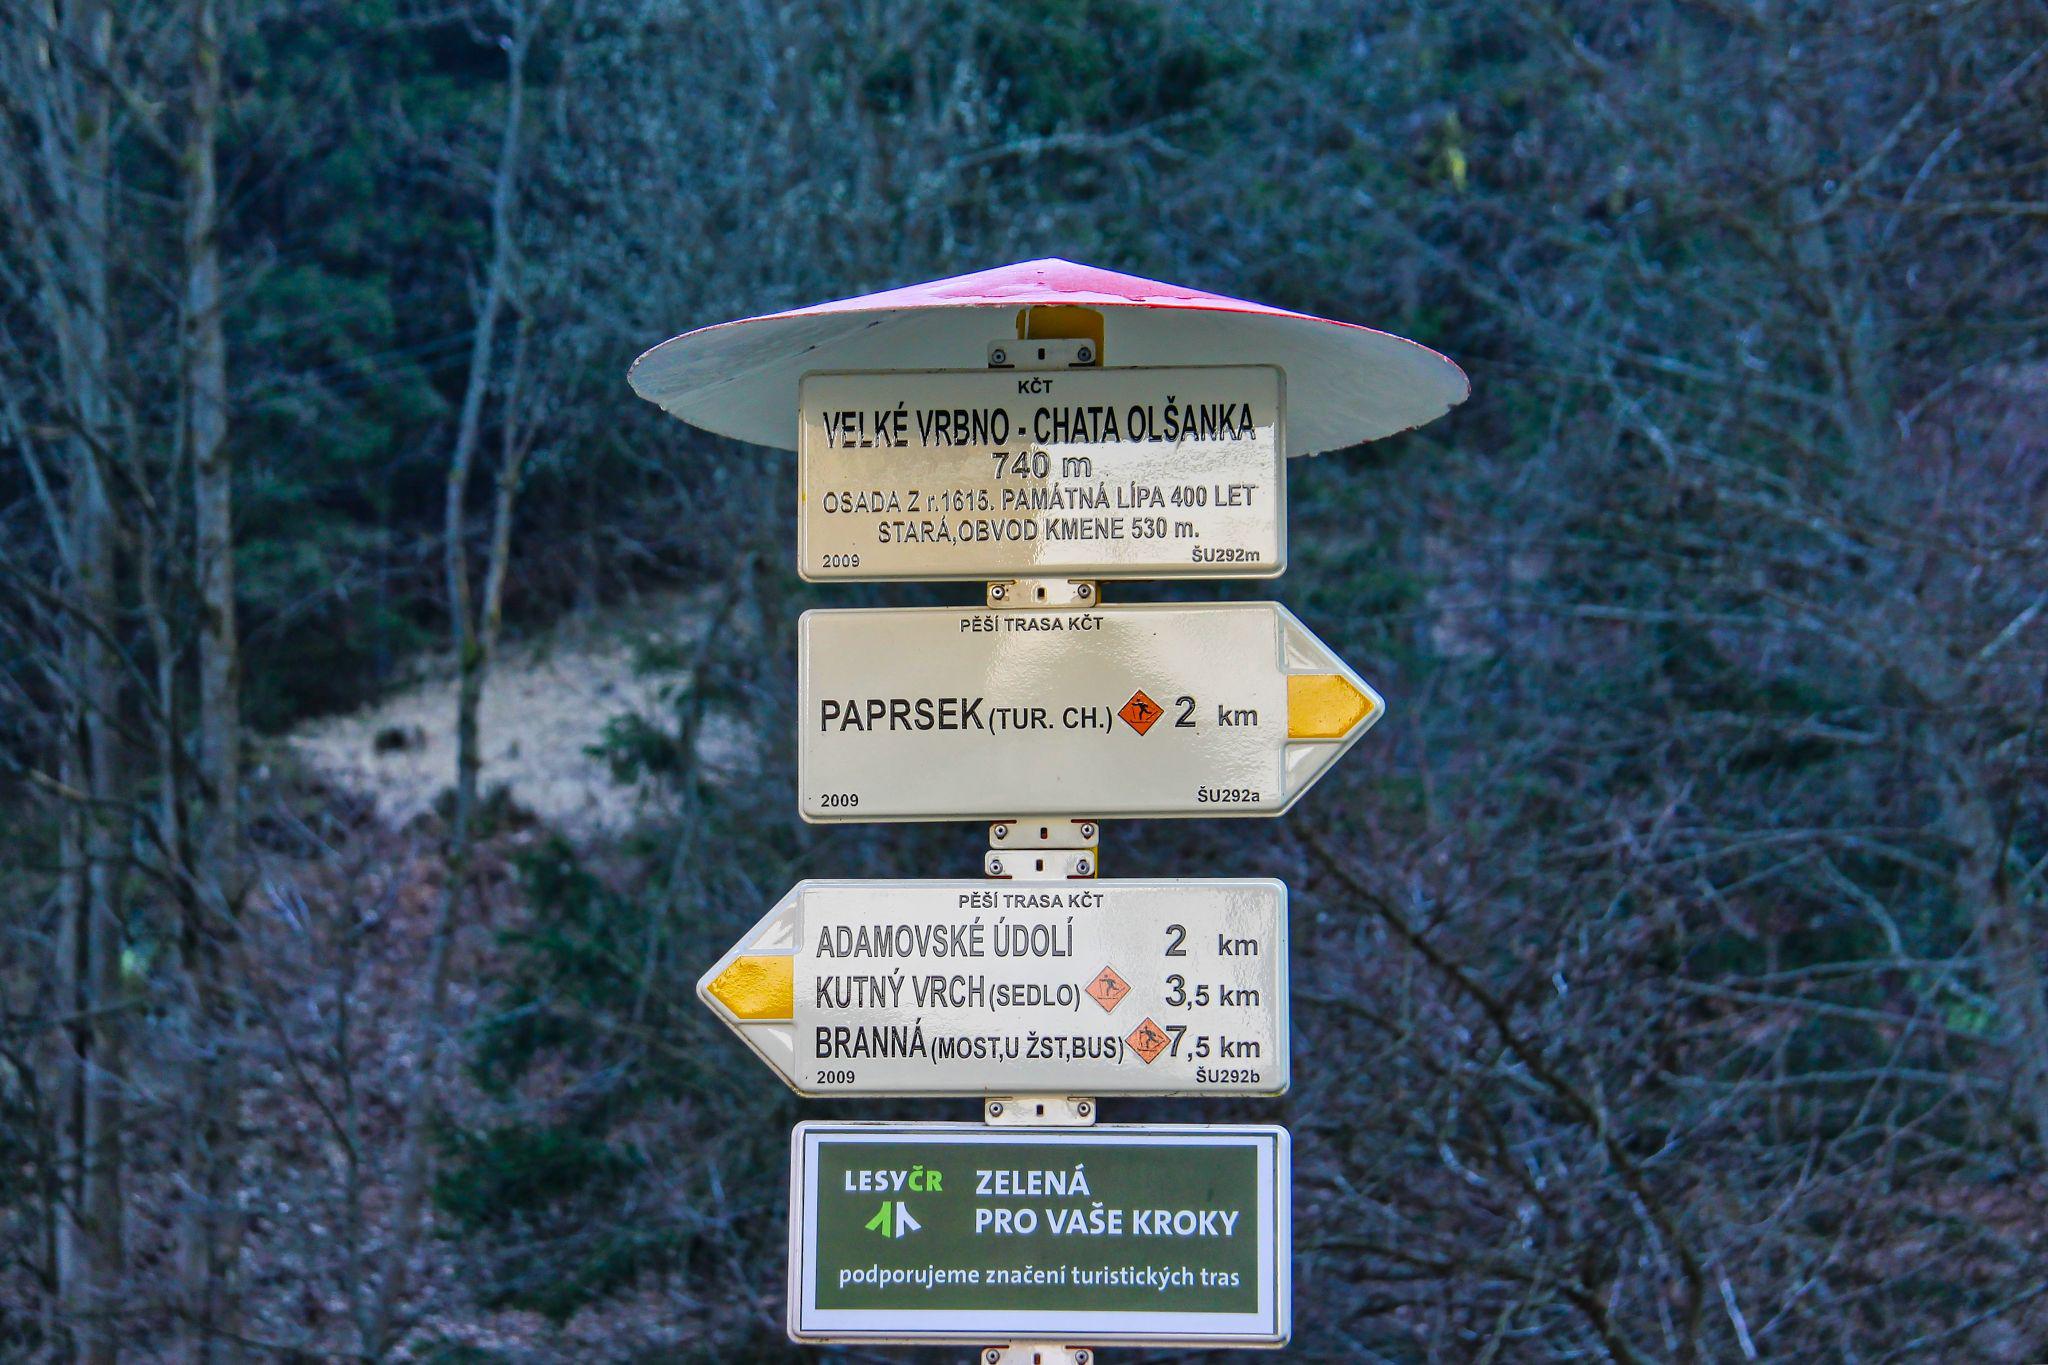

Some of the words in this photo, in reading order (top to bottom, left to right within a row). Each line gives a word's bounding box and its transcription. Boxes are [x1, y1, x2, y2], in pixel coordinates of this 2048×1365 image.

[1018, 378, 1053, 394] KČT
[823, 402, 908, 448] VELKÉ
[916, 408, 1010, 447] VRBNO
[1034, 406, 1118, 444] CHATA
[1128, 396, 1256, 442] OLŠANKA
[992, 451, 1051, 479] 740
[1062, 457, 1092, 478] m
[823, 490, 901, 513] OSADA
[908, 492, 920, 511] Z
[1002, 481, 1110, 510] PAMÁTNÁ
[1118, 482, 1163, 508] LÍPA
[1170, 485, 1208, 507] 400
[1216, 484, 1255, 506] LET
[1046, 519, 1124, 540] KMENE
[1131, 518, 1167, 538] 530
[1174, 521, 1199, 538] m.
[823, 554, 860, 568] 2009
[1192, 547, 1260, 563] ŠU292m
[960, 618, 1000, 633] PĚŠÍ
[1004, 618, 1064, 632] TRASA
[1068, 614, 1104, 631] KČT
[821, 698, 984, 731] PAPRSEK
[989, 709, 1055, 735] (TUR.
[1062, 706, 1113, 733] CH.)
[1175, 696, 1197, 728] 2
[1218, 705, 1259, 726] km
[821, 794, 859, 807] 2009
[1198, 787, 1260, 803] ŠU292a
[959, 892, 999, 909] PĚŠÍ
[1003, 894, 1063, 908] TRASA
[1068, 891, 1104, 908] KČT
[817, 916, 984, 958] ADAMOVSKÉ
[994, 916, 1073, 957] ÚDOLÍ
[1165, 924, 1187, 957] 2
[1219, 935, 1258, 956] km
[817, 968, 905, 1009] KUTNÝ
[912, 976, 985, 1007] VRCH
[989, 984, 1081, 1012] (SEDLO)
[1165, 974, 1210, 1010] 3,5
[1220, 985, 1260, 1006] km
[816, 1017, 927, 1059] BRANNÁ
[1165, 1025, 1210, 1061] 7,5
[1220, 1037, 1260, 1058] km
[817, 1070, 856, 1084] 2009
[1196, 1067, 1261, 1084] ŠU292b
[976, 1163, 1090, 1196] ZELENÁ
[975, 1209, 1038, 1234] PRO
[1045, 1202, 1123, 1235] VAŠE
[1133, 1210, 1239, 1236] KROKY
[839, 1264, 979, 1288] podporujeme
[986, 1265, 1065, 1285] značení
[1071, 1266, 1194, 1290] turistických
[1200, 1270, 1240, 1287] tras
